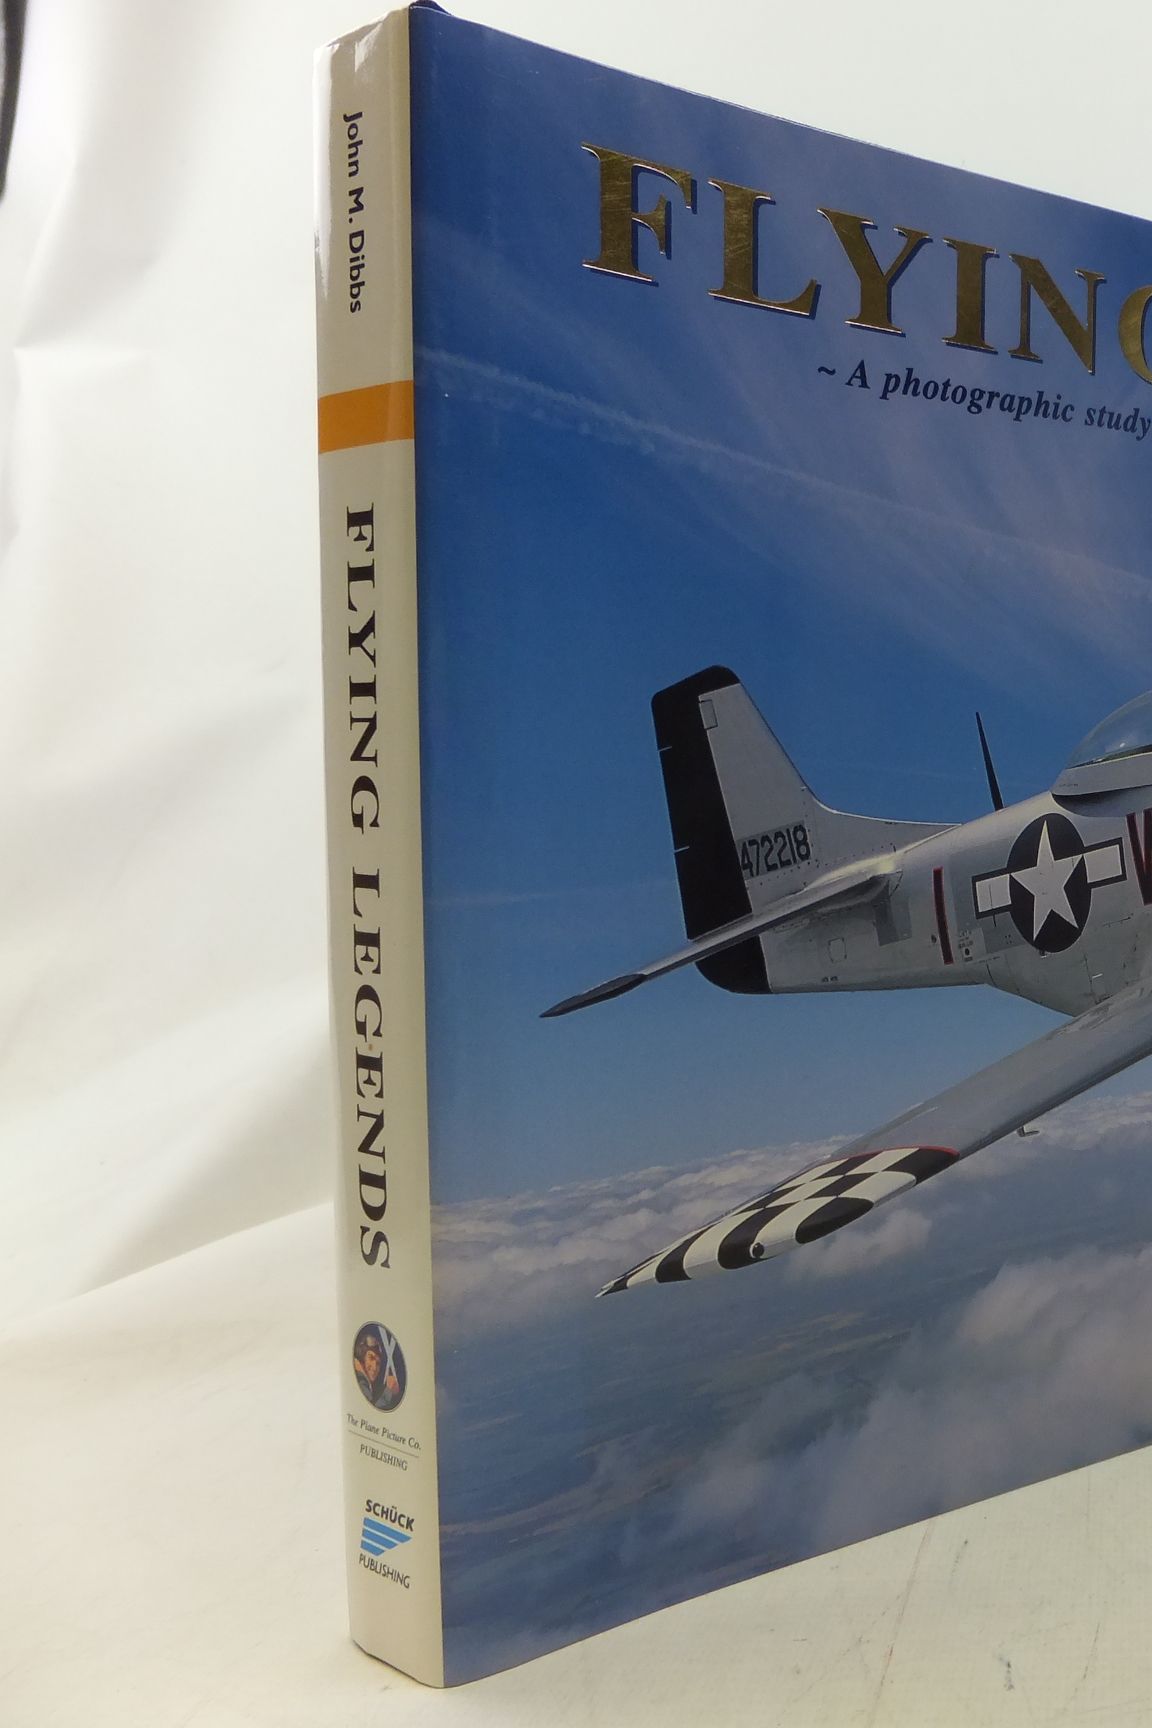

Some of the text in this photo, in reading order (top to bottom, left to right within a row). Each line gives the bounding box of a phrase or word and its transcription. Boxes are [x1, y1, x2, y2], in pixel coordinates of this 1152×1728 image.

[342, 111, 366, 314] John M. Dibbs
[845, 359, 871, 390] A
[879, 367, 1075, 423] photographic
[1084, 406, 1151, 442] study
[740, 824, 812, 878] 472218
[346, 501, 391, 1270] FLYING LEGENDS
[360, 1418, 380, 1435] Plane
[381, 1426, 407, 1445] Picture
[408, 1437, 421, 1450] Co.
[360, 1443, 409, 1472] PUBLISHING
[365, 1499, 415, 1532] SCHÜCK
[359, 1553, 410, 1589] PUBLISHING
